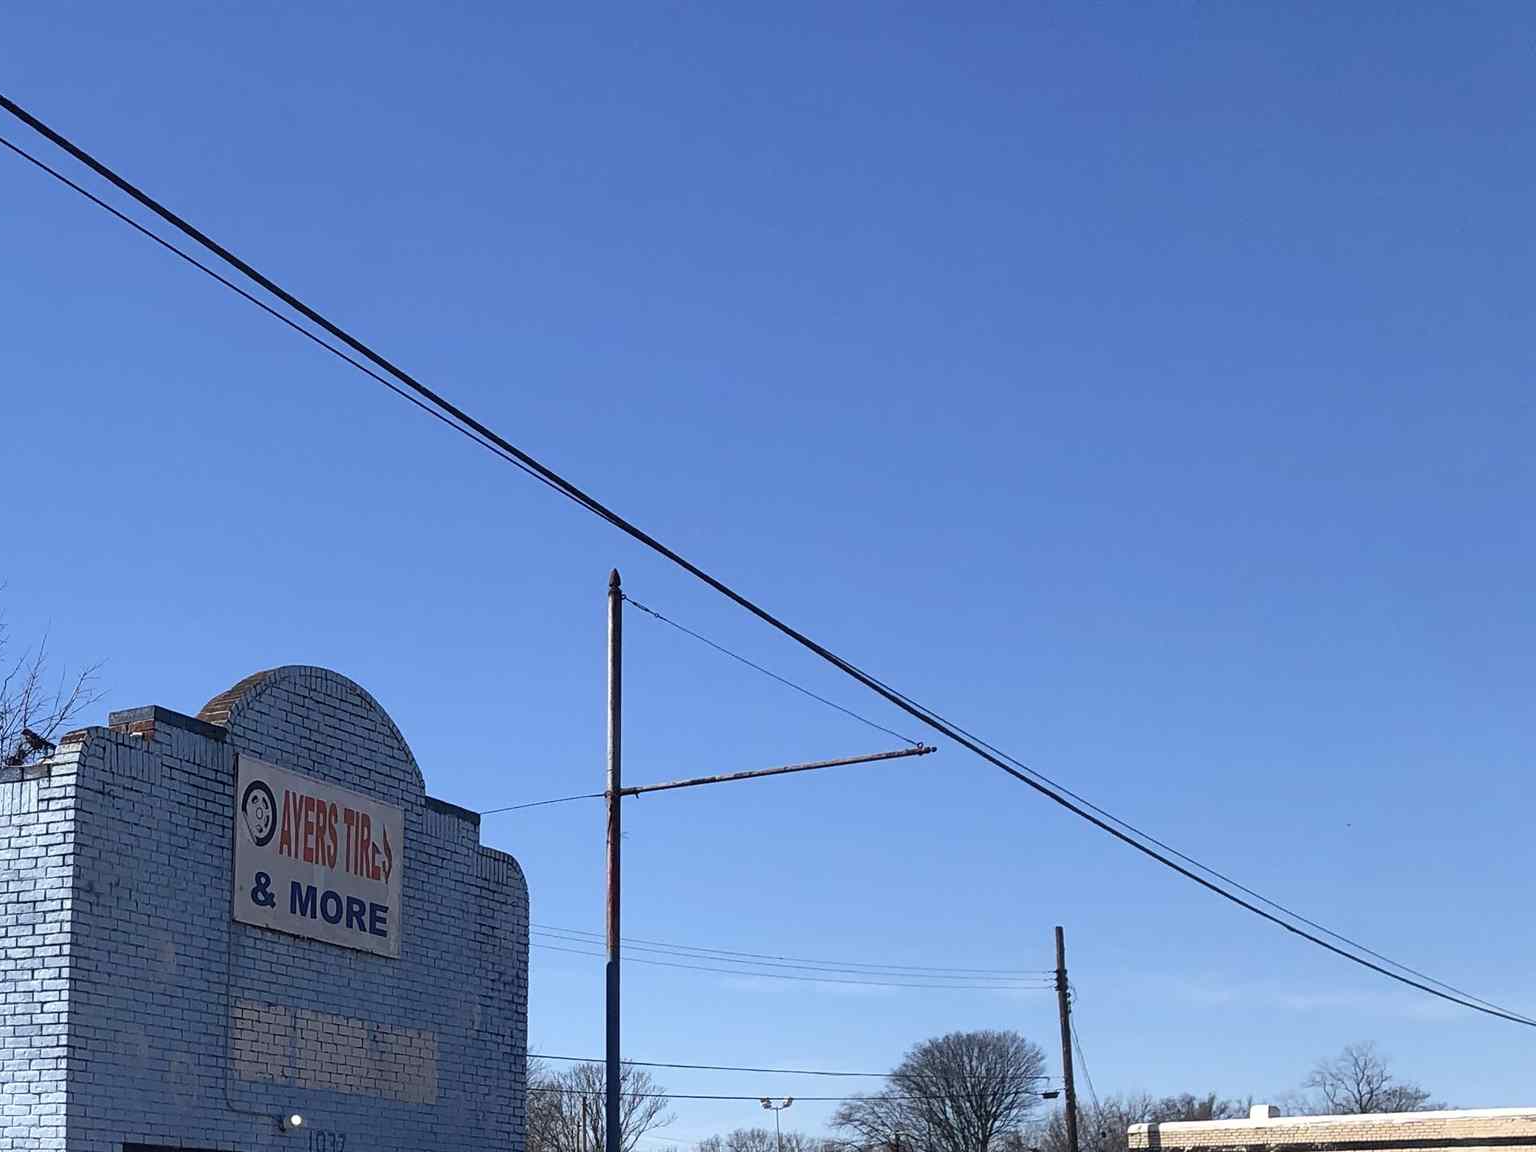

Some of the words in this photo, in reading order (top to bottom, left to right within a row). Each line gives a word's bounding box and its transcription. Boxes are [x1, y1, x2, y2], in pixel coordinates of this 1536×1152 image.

[279, 790, 338, 869] AYERS
[250, 871, 276, 909] &
[290, 881, 389, 938] MORE
